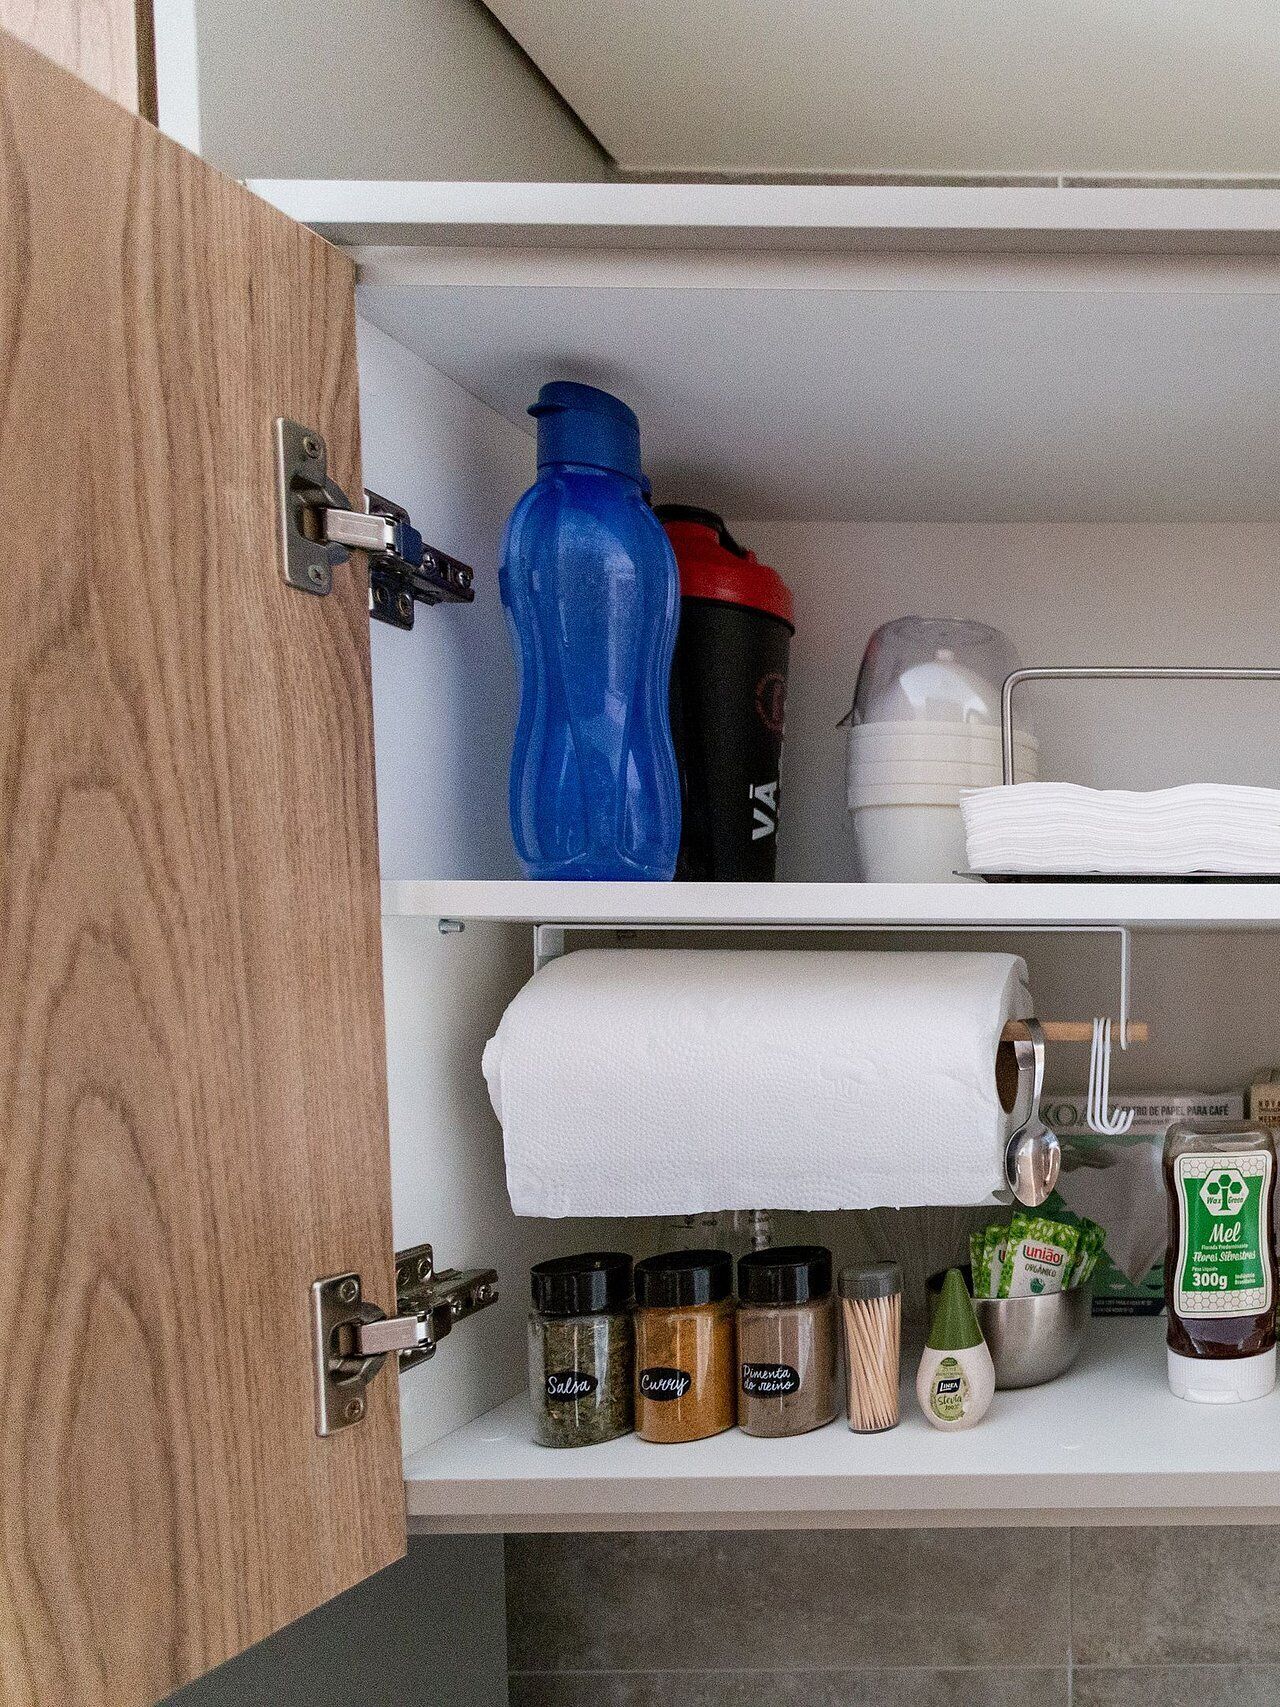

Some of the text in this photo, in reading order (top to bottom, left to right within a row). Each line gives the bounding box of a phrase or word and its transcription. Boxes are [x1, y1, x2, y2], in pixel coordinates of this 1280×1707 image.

[1187, 1105, 1207, 1116] PARA
[1209, 1103, 1229, 1116] CAFÉ
[1208, 1221, 1241, 1243] Mel
[1026, 1246, 1060, 1264] união
[1192, 1250, 1256, 1262] Flores Silvestres
[1192, 1272, 1228, 1290] 300g
[743, 1364, 791, 1379] Pimenta
[547, 1376, 591, 1394] Salsa
[641, 1374, 690, 1396] Curry
[757, 1380, 795, 1391] reino
